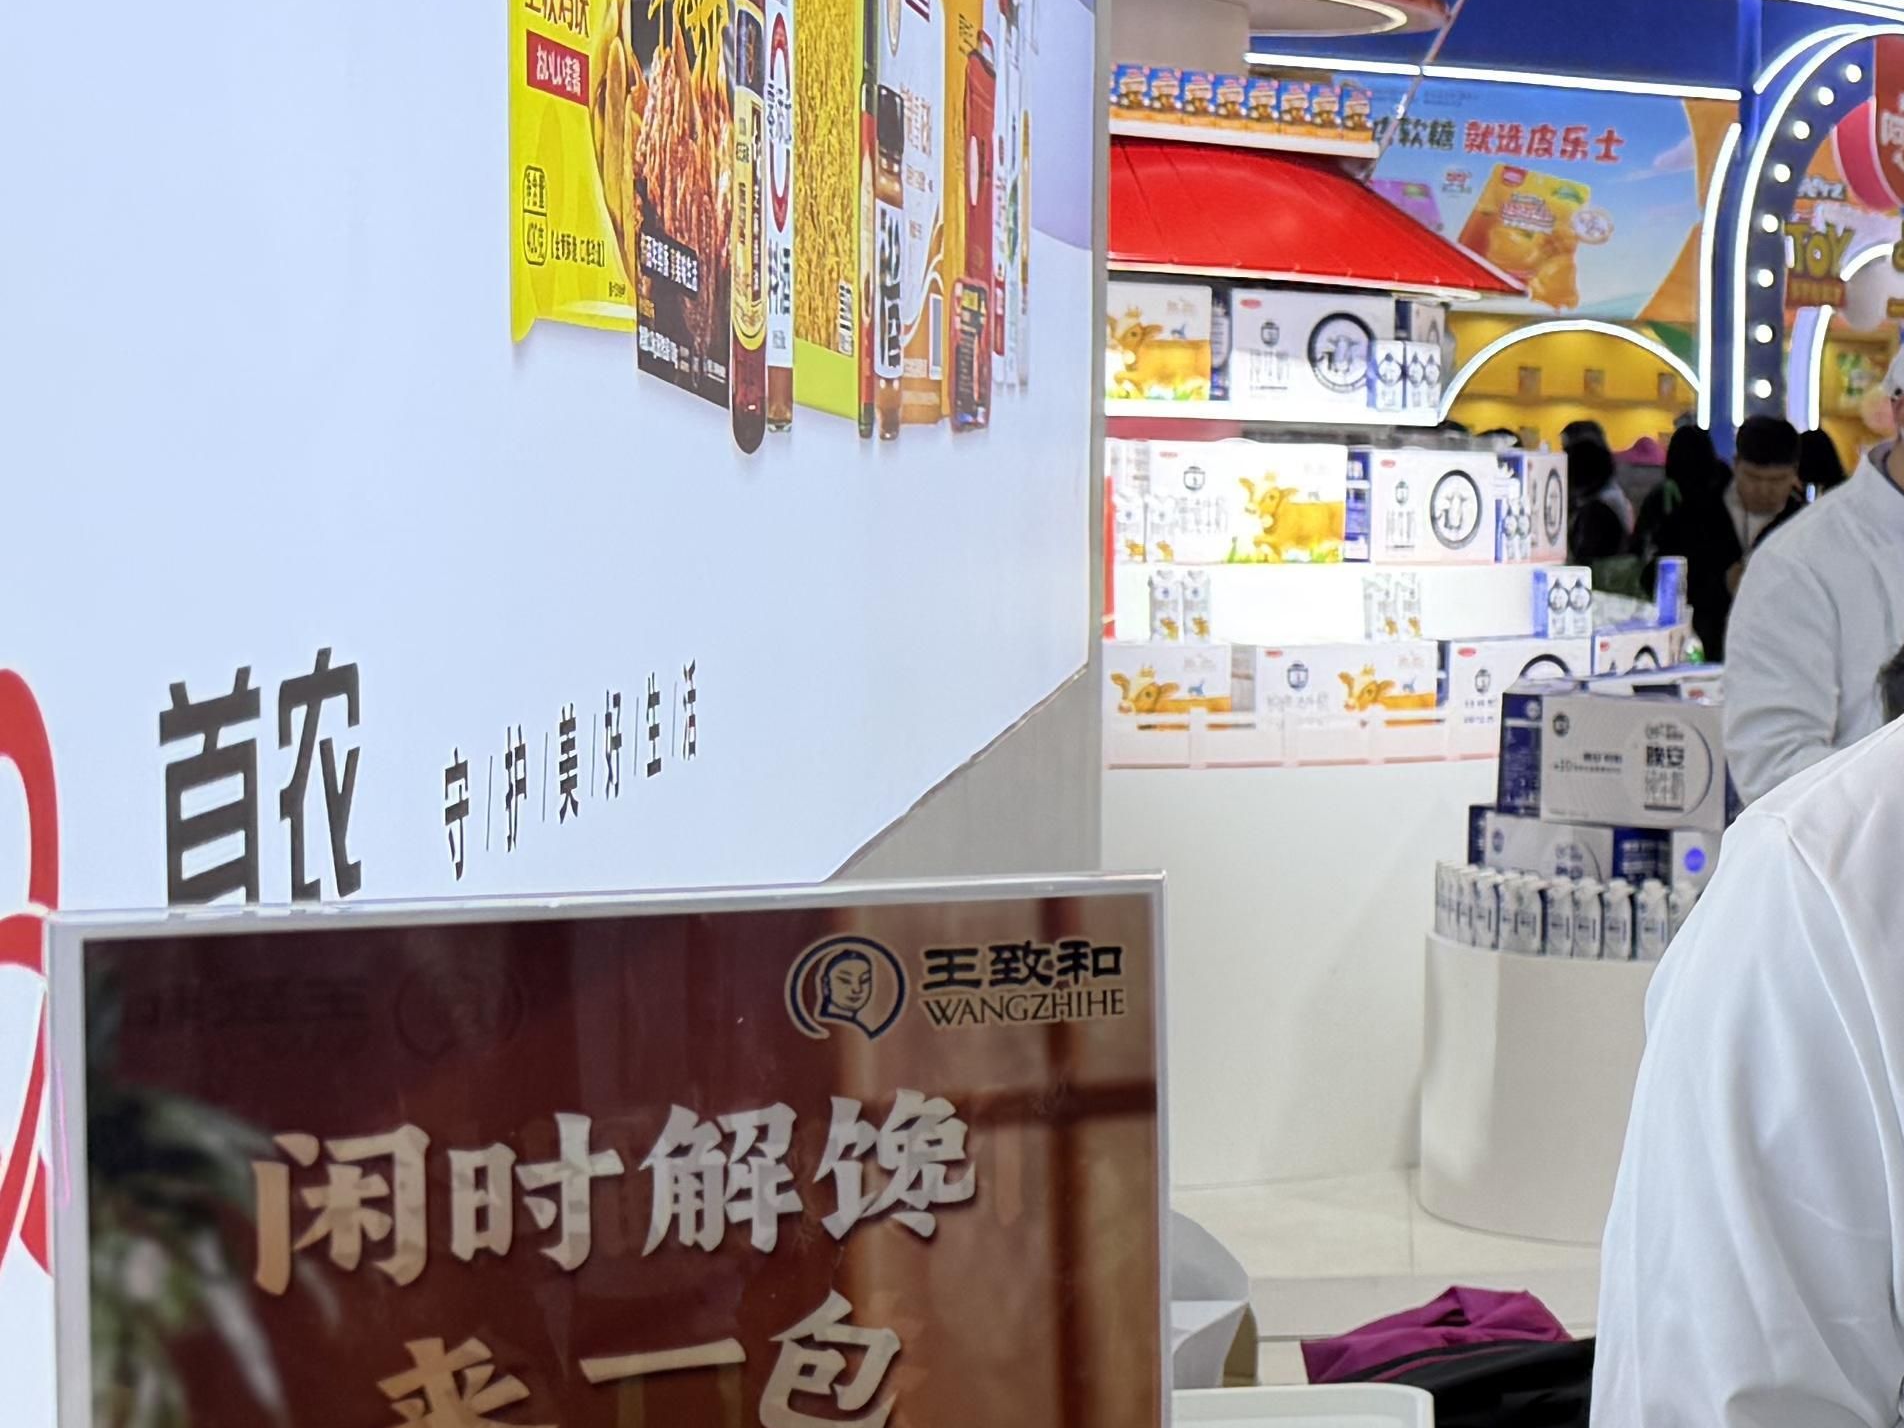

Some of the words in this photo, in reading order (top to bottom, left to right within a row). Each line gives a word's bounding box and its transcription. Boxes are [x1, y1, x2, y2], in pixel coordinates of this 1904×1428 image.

[1463, 121, 1624, 163] 就选皮乐士
[159, 645, 363, 908] 首农
[920, 939, 1125, 992] 王致和
[923, 986, 1127, 1030] WANGZHIHE
[251, 1088, 979, 1297] 闲时解馋
